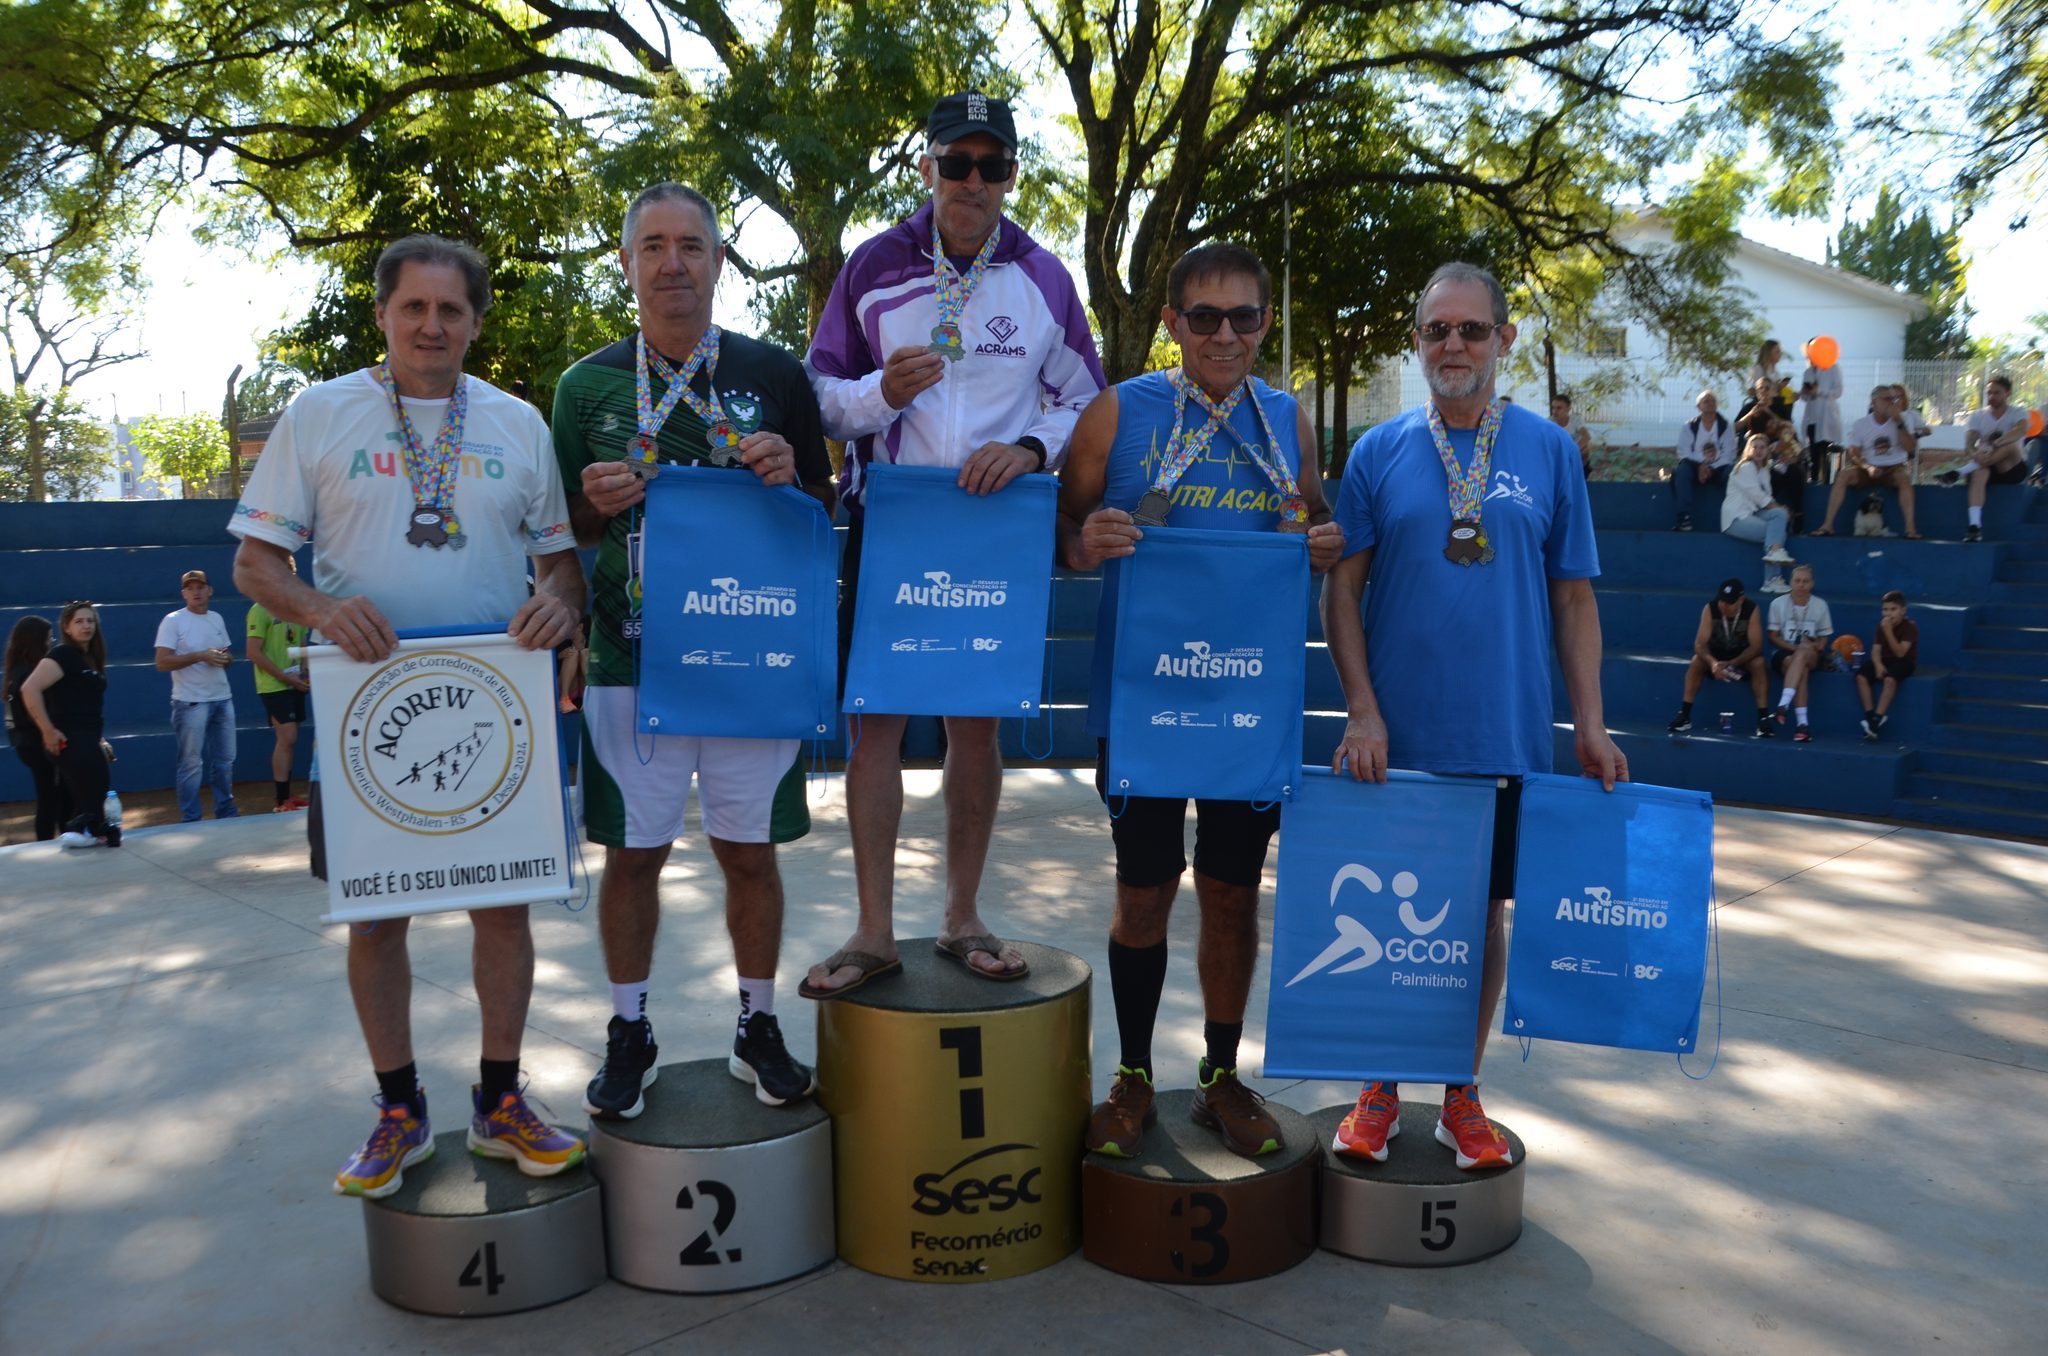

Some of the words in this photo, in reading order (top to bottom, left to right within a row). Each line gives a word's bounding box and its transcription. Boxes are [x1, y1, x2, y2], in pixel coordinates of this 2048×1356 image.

[968, 113, 988, 122] RUN
[975, 343, 1026, 356] ACRAMS
[349, 449, 504, 480] Aumo
[1218, 487, 1283, 512] AÇÃO
[683, 591, 797, 617] Autismo
[895, 583, 1006, 607] Autismo
[1154, 654, 1263, 678] Autismo
[353, 668, 401, 720] Associação
[402, 661, 417, 672] de
[419, 657, 486, 678] Corredores
[485, 674, 498, 687] de
[496, 685, 514, 708] Rua
[374, 685, 475, 760] ACORFW
[349, 746, 377, 799] Frederico
[493, 772, 520, 804] Desde
[515, 742, 527, 771] 2024
[341, 872, 383, 898] VOCÊ
[387, 871, 397, 893] É
[401, 873, 411, 892] O
[416, 869, 445, 890] SEU
[450, 864, 496, 887] ÚNICO
[501, 857, 556, 881] LIMITE!
[1555, 898, 1668, 929] Autismo
[1385, 938, 1469, 964] GCOR
[1391, 971, 1467, 988] Palmitinho
[675, 1179, 742, 1266] 2
[911, 1222, 1042, 1250] Fecomércio
[1170, 1191, 1230, 1278] 3
[1420, 1200, 1456, 1251] 5
[458, 1241, 505, 1295] 4
[913, 1257, 986, 1276] Senac
